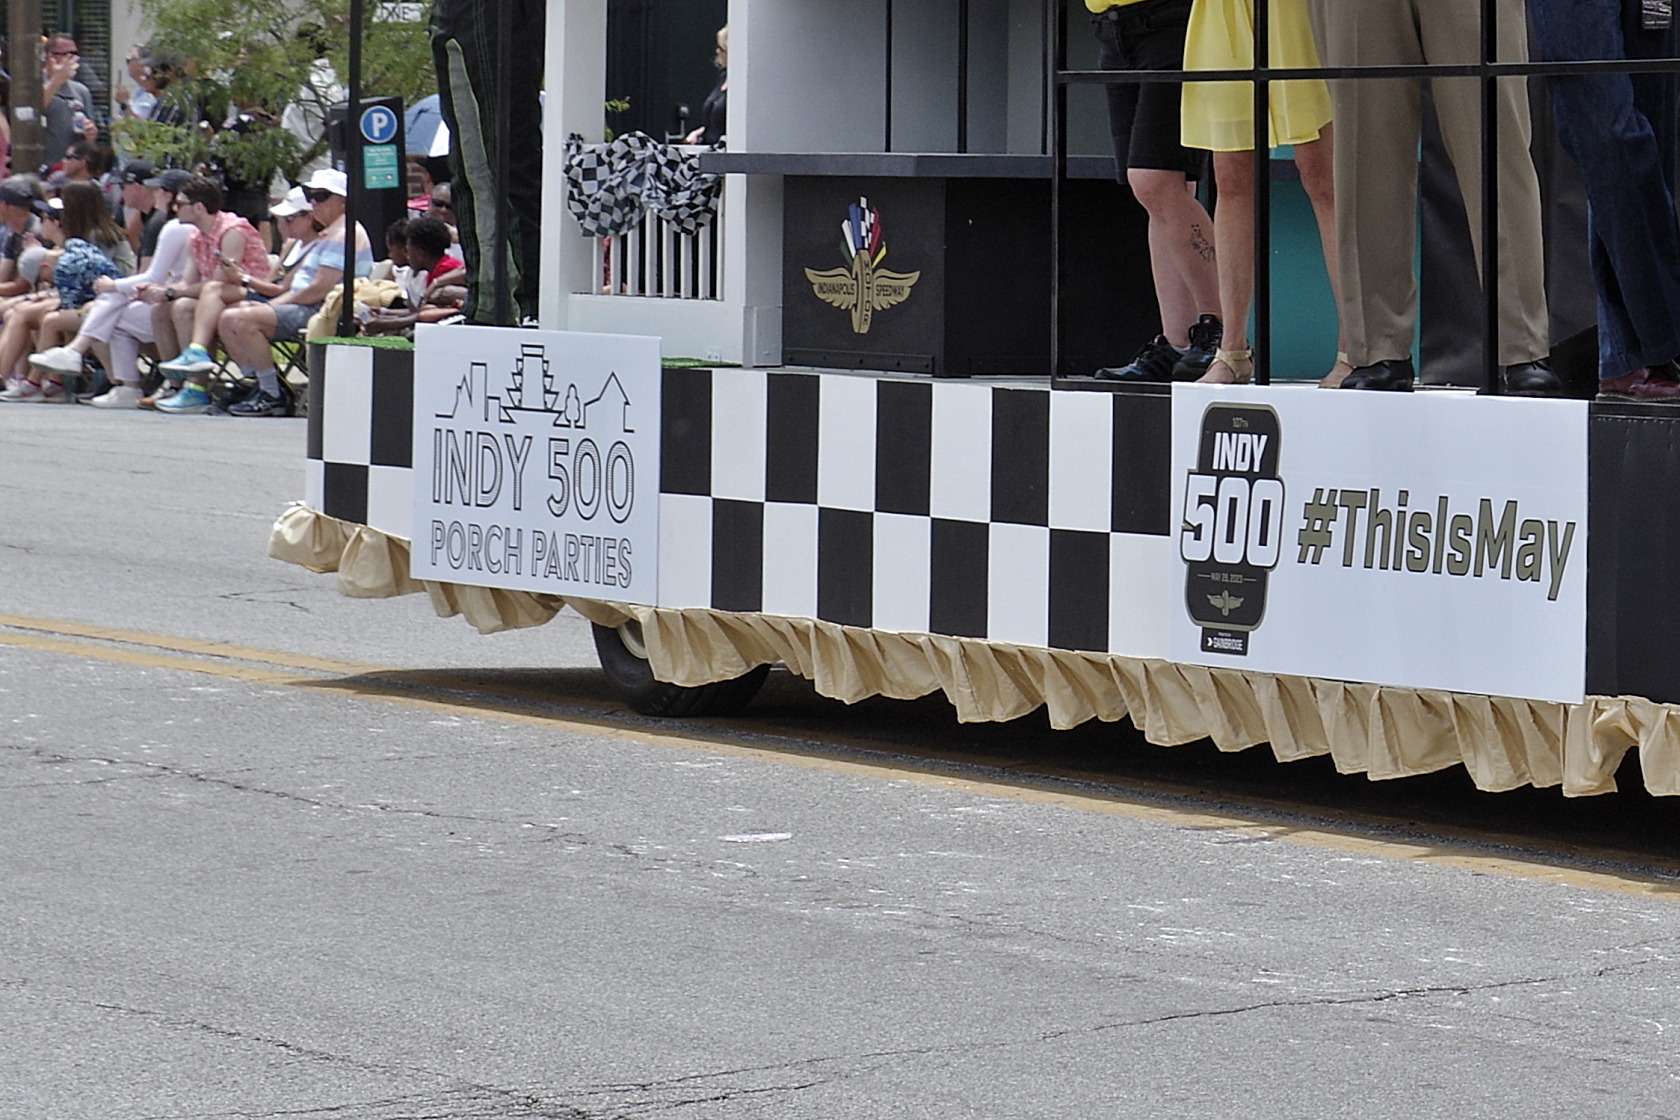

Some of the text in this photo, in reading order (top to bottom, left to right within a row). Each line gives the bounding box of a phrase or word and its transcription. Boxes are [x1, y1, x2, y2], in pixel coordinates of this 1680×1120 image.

[371, 112, 389, 138] P
[818, 282, 856, 296] INDIANAPOLIS
[863, 261, 872, 322] MOTOR
[875, 284, 905, 298] SPEEDWAY
[432, 428, 635, 524] INDY 500
[1212, 432, 1268, 472] INDY
[1182, 474, 1284, 567] 500
[1297, 487, 1577, 602] #ThisIsMay
[431, 519, 633, 589] PORCH PARTIES
